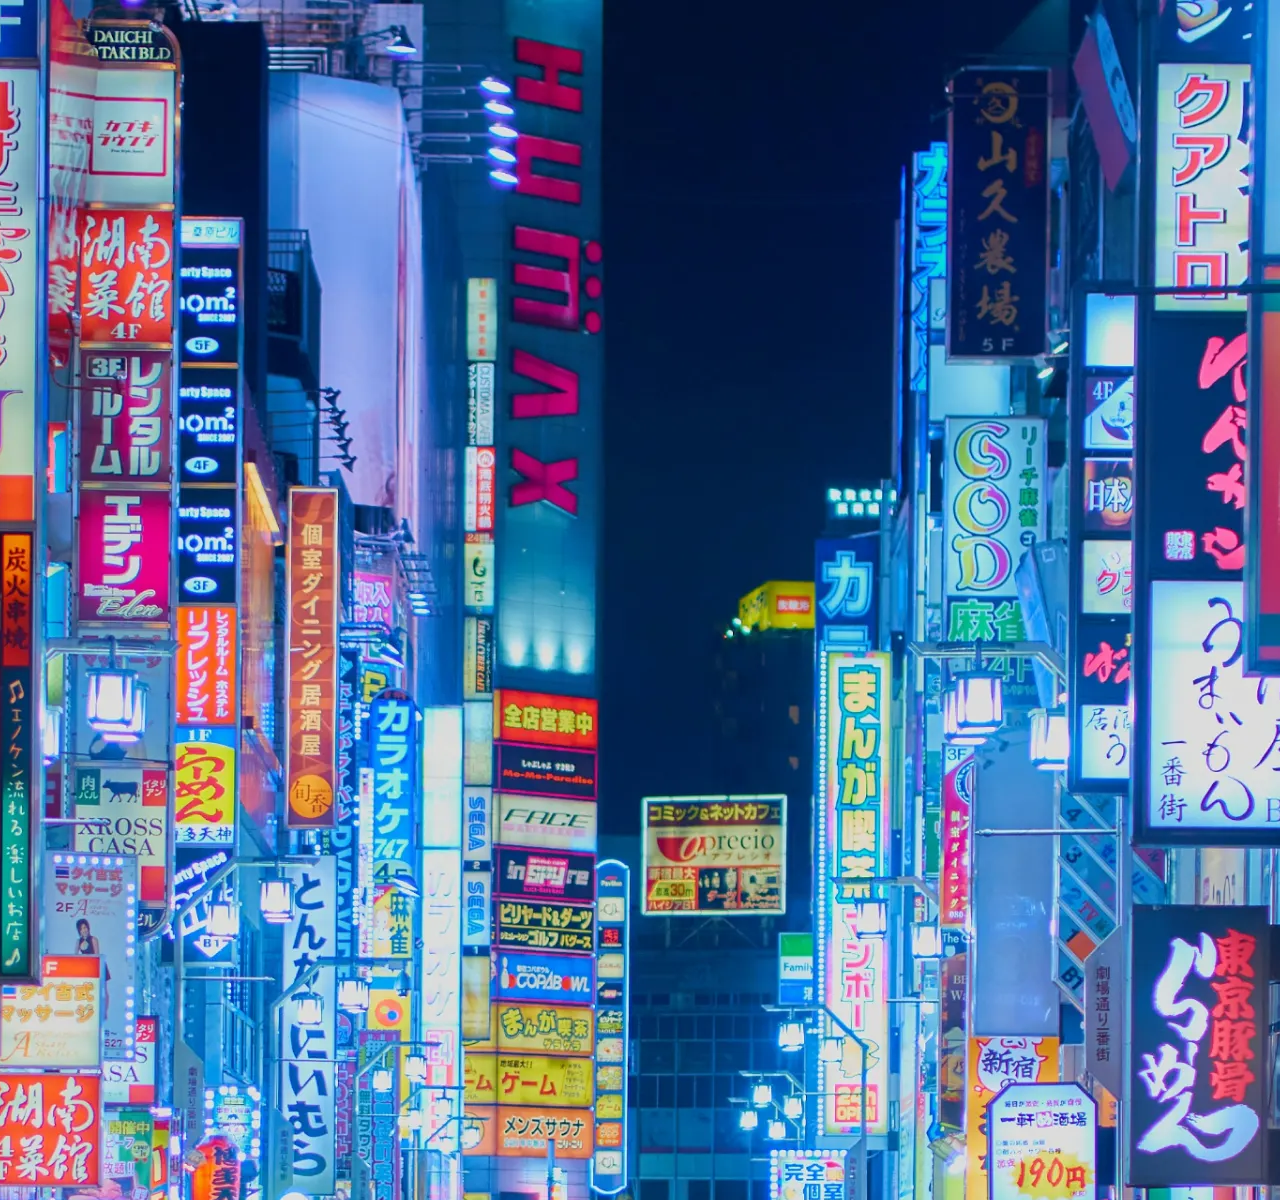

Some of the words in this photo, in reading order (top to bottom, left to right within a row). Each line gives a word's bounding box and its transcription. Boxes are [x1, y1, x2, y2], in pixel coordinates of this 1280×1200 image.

[94, 31, 152, 44] DAIICHI
[105, 119, 154, 132] カブキ
[96, 133, 160, 148] ラウンジ
[1172, 73, 1229, 300] クアトロ
[111, 323, 142, 339] 4F
[194, 340, 211, 351] 5F
[982, 338, 1015, 353] 5F
[92, 358, 123, 376] 3F
[128, 356, 165, 477] レンタル
[91, 387, 124, 477] ルーム
[193, 460, 210, 471] 4F
[952, 421, 1012, 591] GOD
[102, 495, 143, 585] エデン
[193, 580, 211, 591] 3F
[96, 589, 163, 618] Eden
[300, 523, 323, 757] 個室ダイニング居酒屋
[187, 610, 209, 722] リフレッシュ
[504, 703, 593, 736] 全店営業中
[188, 729, 212, 742] 1F
[947, 748, 967, 761] 3F
[376, 701, 410, 834] カラオケ
[81, 775, 96, 790] 肉
[841, 671, 878, 898] まんが喫茶
[1158, 738, 1189, 823] 一番街
[469, 796, 485, 851] SEGA
[504, 808, 593, 828] FACE
[649, 803, 781, 821] コミック&ネットカフェ
[78, 816, 164, 836] XROSS
[89, 837, 156, 856] CASA
[374, 838, 410, 859] 747
[468, 881, 485, 937] SEGA
[203, 938, 220, 948] B1
[287, 873, 329, 1177] とんかにいむら
[501, 1008, 589, 1038] まんが喫茶
[1095, 966, 1112, 1062] 劇場通り一番街
[1209, 928, 1257, 1102] 東京豚骨
[982, 1049, 1037, 1079] 新宿
[501, 1071, 557, 1097] ゲーム
[504, 1116, 584, 1136] メンズサウナ
[785, 1163, 825, 1181] 完全
[1016, 1156, 1087, 1189] 190円
[803, 1183, 843, 1200] 個室
